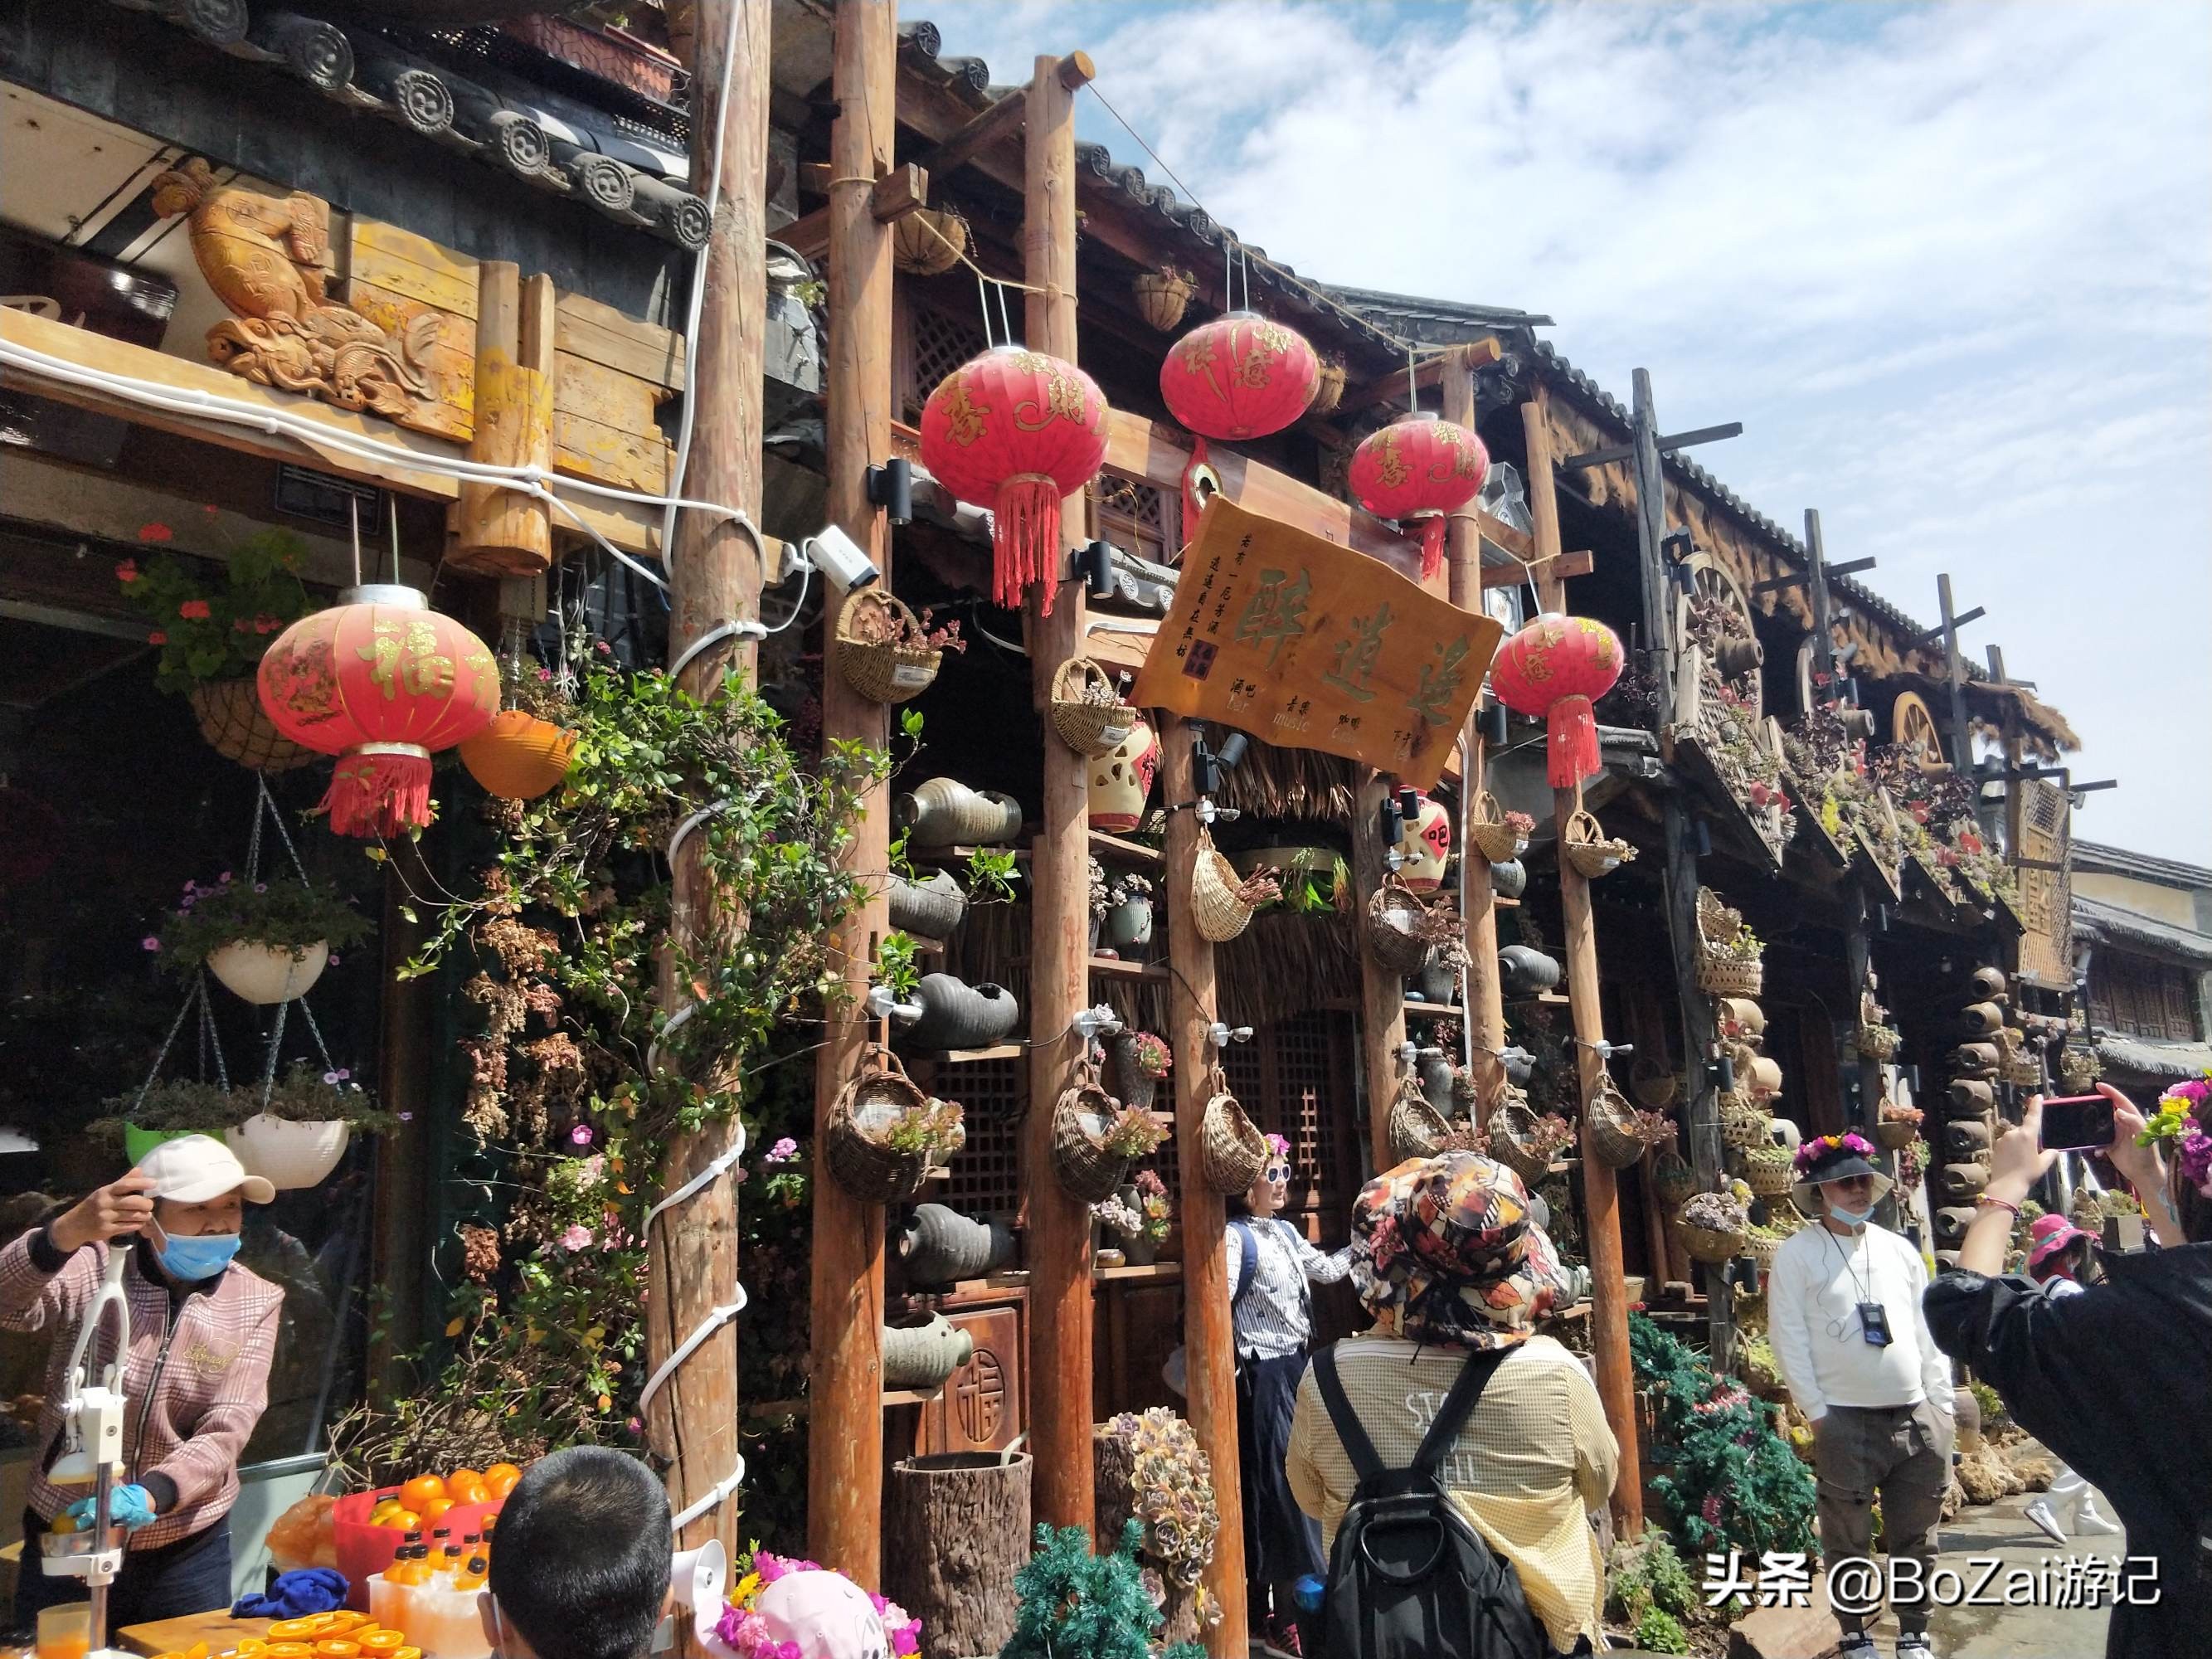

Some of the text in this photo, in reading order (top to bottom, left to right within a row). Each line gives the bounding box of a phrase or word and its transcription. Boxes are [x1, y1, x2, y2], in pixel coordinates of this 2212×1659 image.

[355, 618, 455, 701] 福
[1230, 679, 1257, 698] 酒吧
[1273, 713, 1310, 733] music
[1428, 825, 1449, 848] 吧
